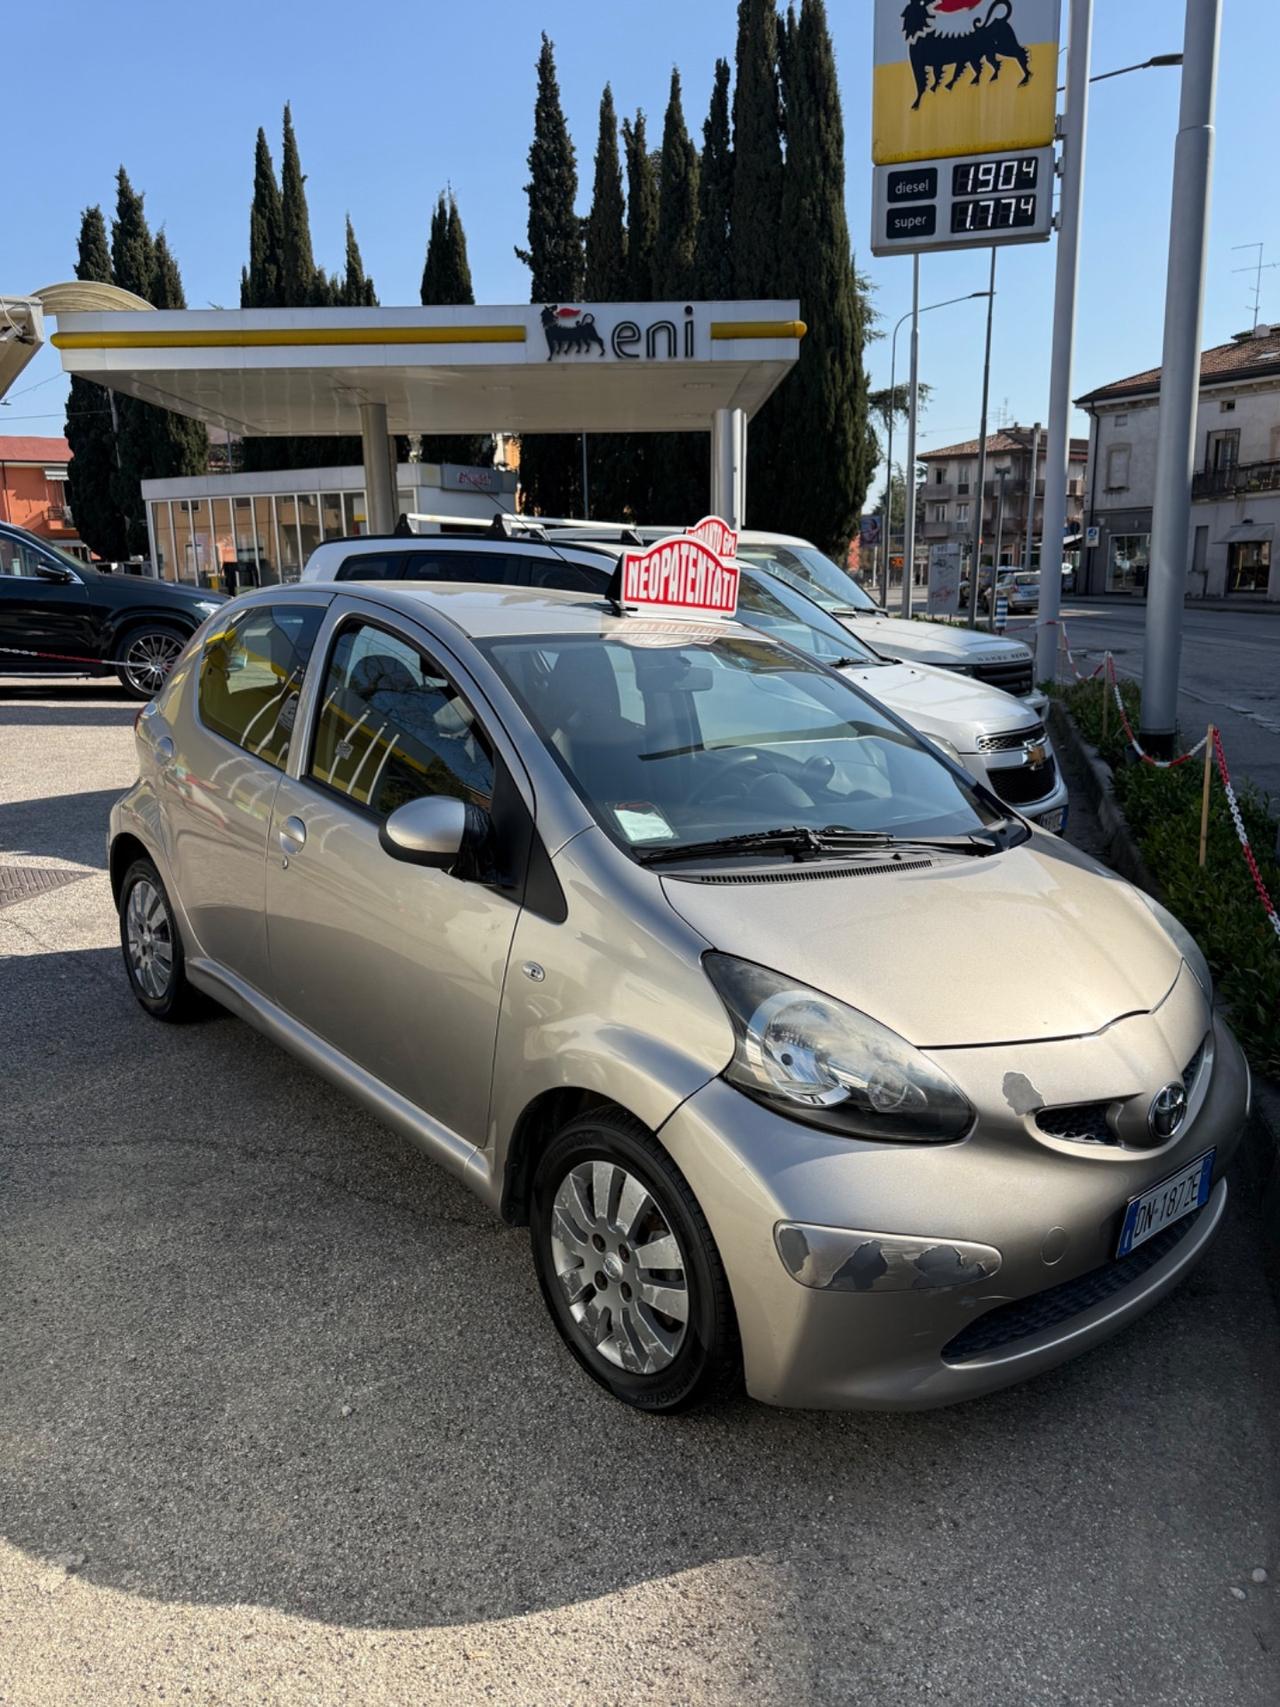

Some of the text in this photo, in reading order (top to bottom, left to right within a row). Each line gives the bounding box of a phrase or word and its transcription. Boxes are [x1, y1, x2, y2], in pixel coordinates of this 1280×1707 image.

[895, 179, 929, 195] diesel
[894, 197, 1034, 232] super 1.774
[611, 305, 694, 358] eni
[626, 542, 736, 609] NEOPATENTATI
